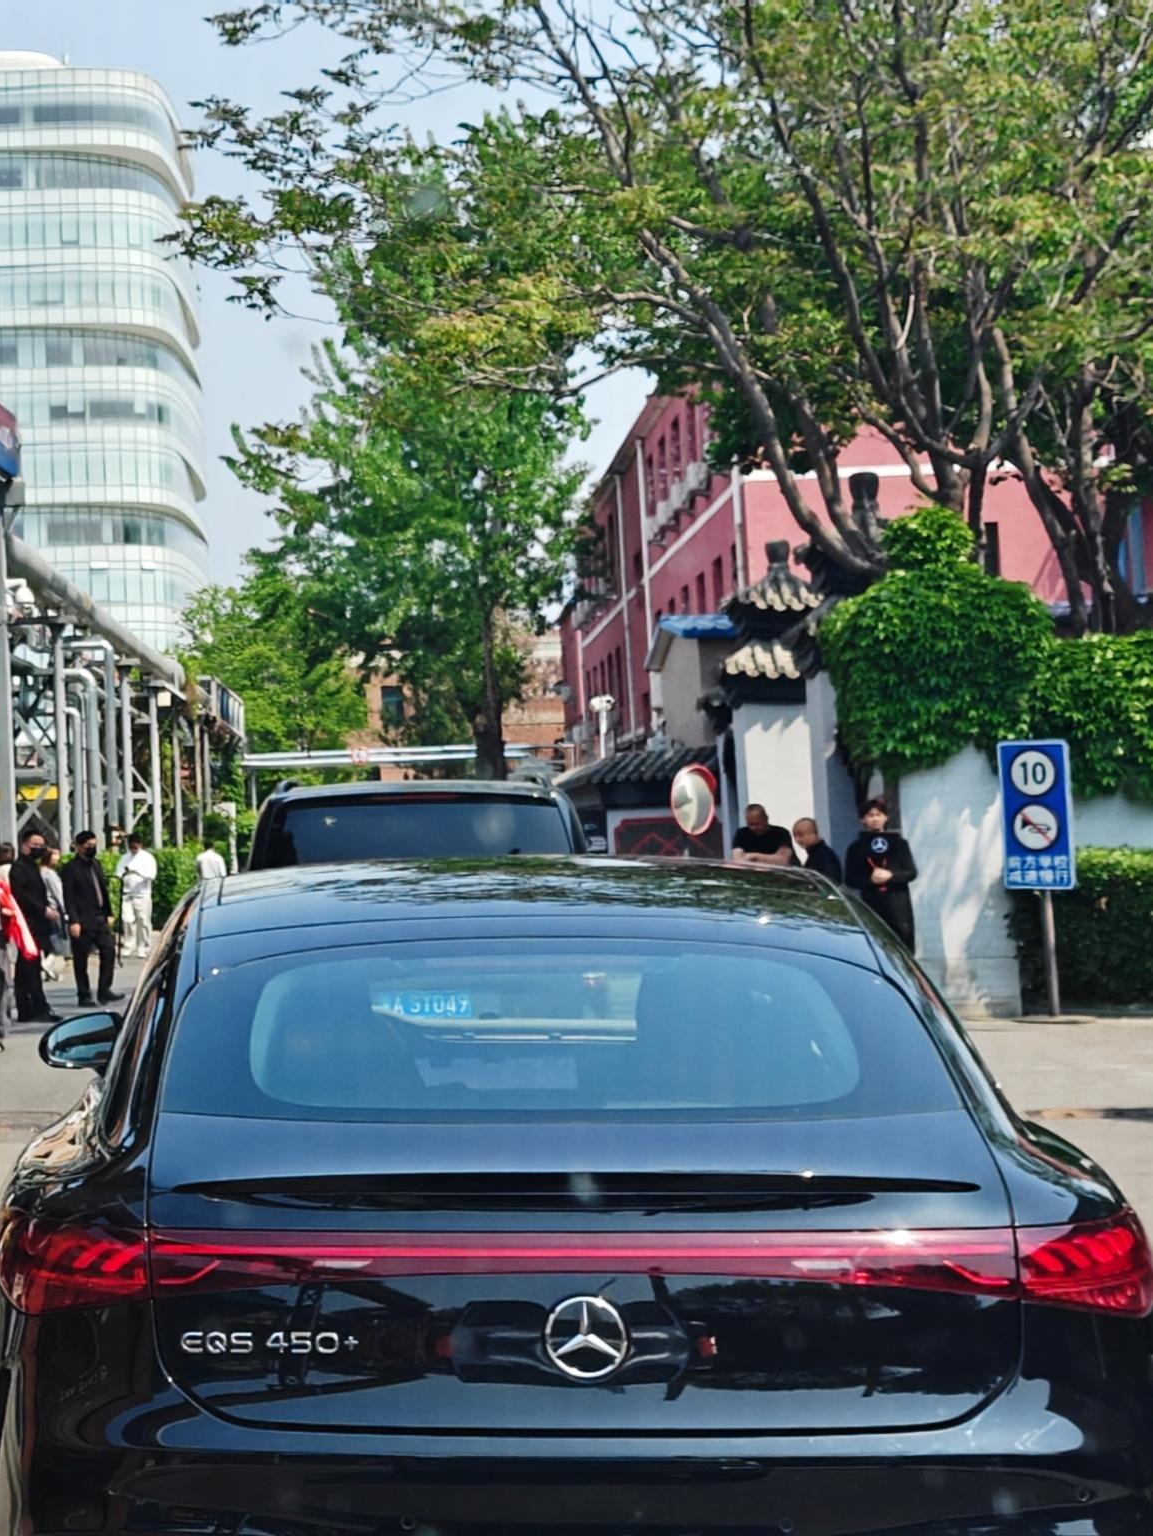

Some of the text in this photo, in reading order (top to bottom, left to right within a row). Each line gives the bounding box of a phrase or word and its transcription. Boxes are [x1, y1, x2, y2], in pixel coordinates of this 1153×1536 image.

[1020, 762, 1046, 785] 10
[180, 1331, 359, 1353] EQS 450+
